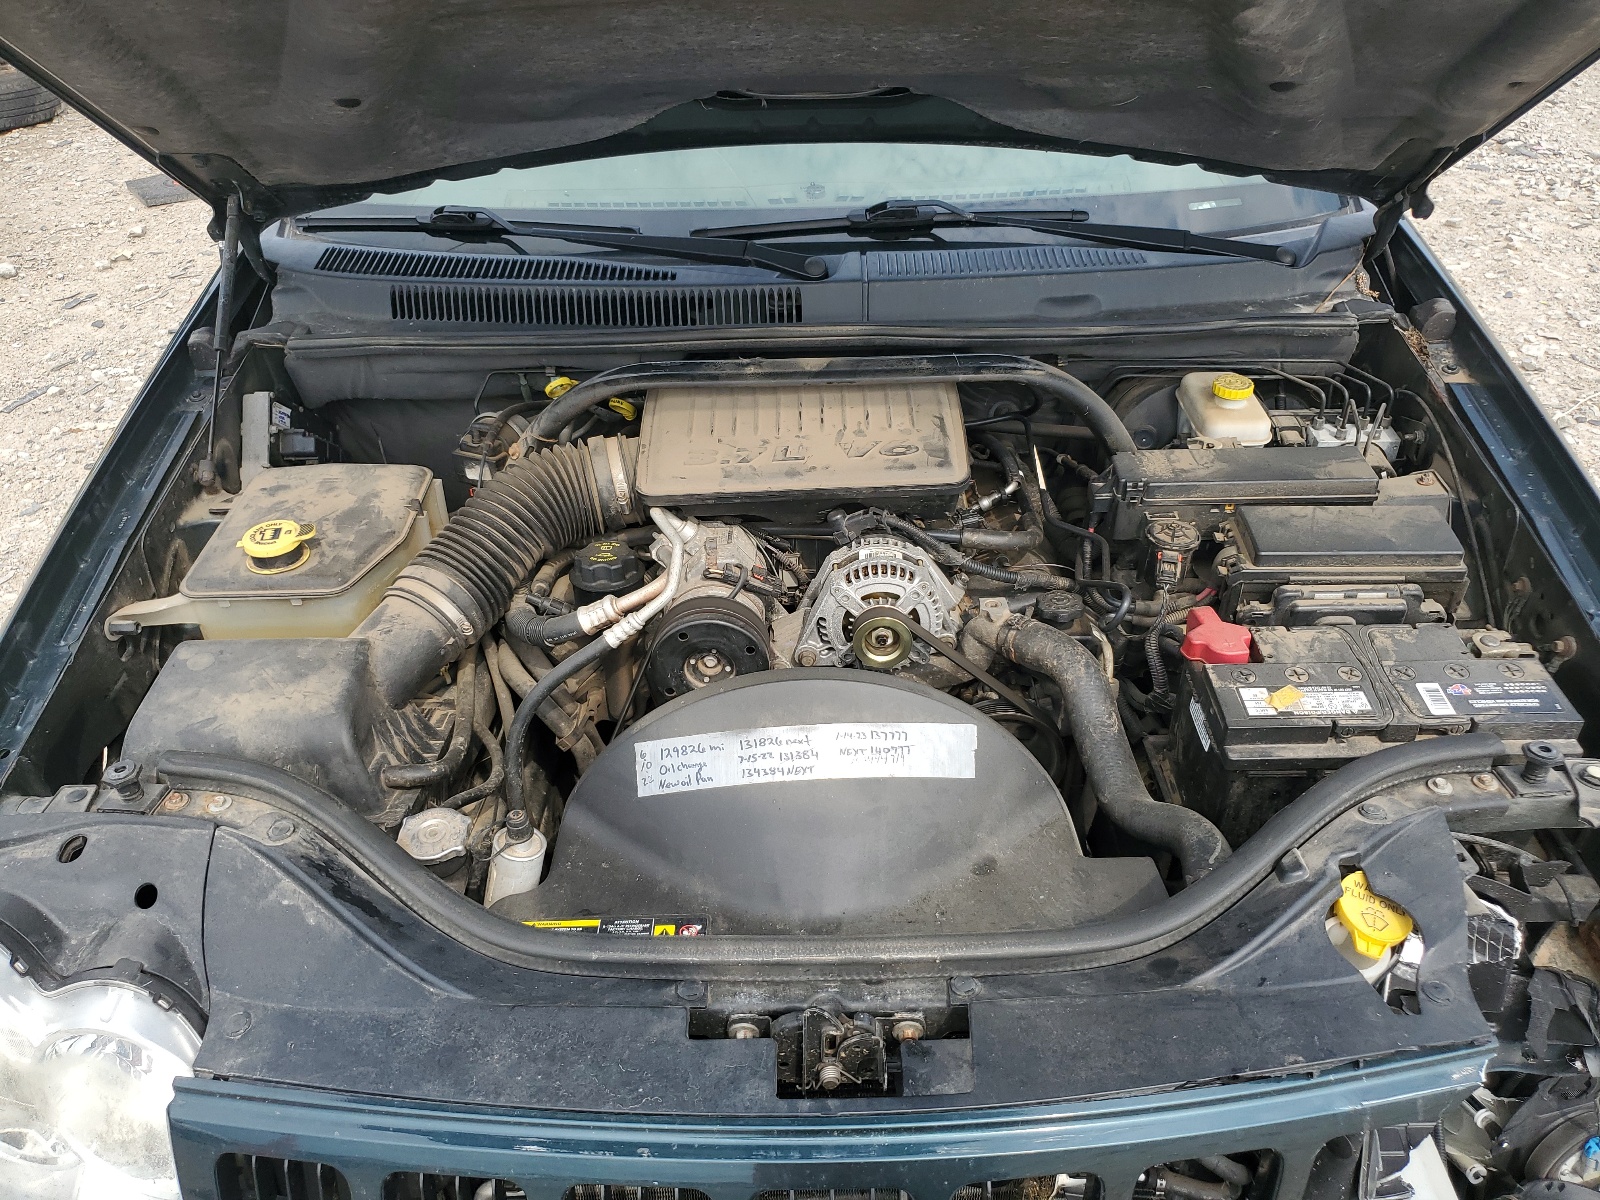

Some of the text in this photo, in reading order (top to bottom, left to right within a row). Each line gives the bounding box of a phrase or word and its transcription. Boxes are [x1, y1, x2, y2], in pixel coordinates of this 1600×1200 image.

[739, 734, 812, 750] 131826 next
[660, 742, 725, 760] 129826 mi
[839, 747, 867, 756] NEXT
[659, 761, 708, 775] Oil change
[741, 764, 816, 778] 134384 NEXT
[658, 772, 714, 790] New oil Pan
[1344, 886, 1406, 916] FLUID ONLY
